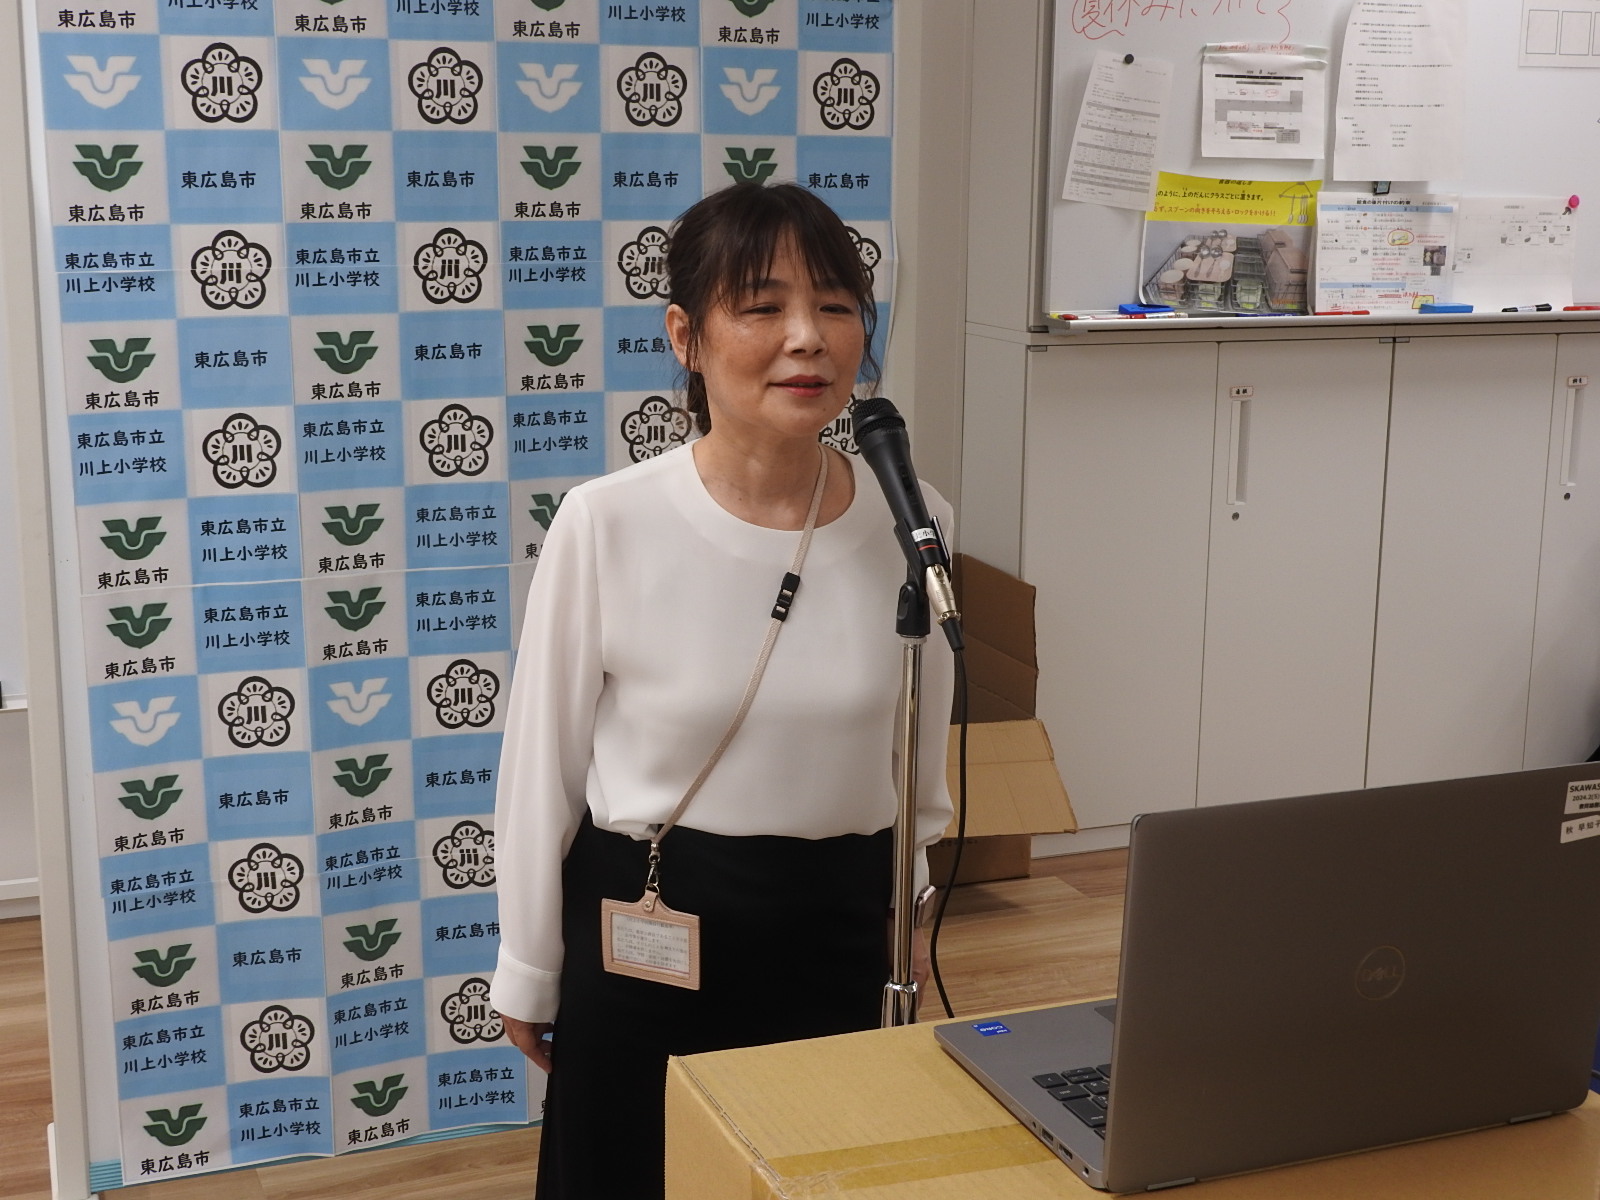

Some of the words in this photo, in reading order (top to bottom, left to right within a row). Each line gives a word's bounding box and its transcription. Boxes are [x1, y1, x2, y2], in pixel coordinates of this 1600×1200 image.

[397, 0, 479, 16] 川上小学校
[608, 5, 685, 22] 川上小学校
[58, 9, 135, 28] 東広島市
[295, 14, 366, 33] 東広島市
[807, 13, 879, 29] 川上小学校
[513, 20, 580, 38] 東広島市
[718, 26, 780, 44] 東広島市
[211, 76, 233, 96] 川
[436, 79, 455, 98] 川
[642, 83, 660, 102] 川
[836, 88, 854, 106] 川
[182, 171, 256, 188] 東広島市
[407, 171, 474, 187] 東広島市
[613, 171, 678, 187] 東広島市
[808, 173, 869, 189] 東広島市
[1156, 190, 1264, 201] のように、上のだんにクラスごとに置きます。
[69, 204, 144, 222] 東広島市
[301, 202, 372, 219] 東広島市
[515, 201, 581, 218] 東広島市
[65, 252, 154, 269] 東広島市立
[296, 248, 379, 265] 東広島市立
[509, 246, 587, 261] 東広島市立
[220, 263, 241, 284] 川
[440, 259, 459, 279] 川
[509, 266, 586, 282] 川上小学校
[67, 276, 155, 293] 川上小学校
[296, 271, 379, 287] 川上小学校
[415, 343, 482, 361] 東広島市
[617, 337, 672, 354] 東広島
[195, 350, 267, 368] 東広島市
[311, 381, 381, 400] 東広島市
[521, 373, 585, 391] 東広島市
[85, 390, 159, 409] 東広島市
[303, 419, 384, 437] 東広島市立
[513, 410, 587, 427] 東広島市立
[834, 418, 850, 436] 川
[78, 429, 165, 449] 東広島市立
[446, 434, 466, 453] 川
[515, 435, 588, 453] 川上小学校
[646, 425, 665, 444] 川
[231, 444, 253, 464] 川
[305, 446, 385, 464] 川上小学校
[80, 456, 166, 476] 川上小学校
[416, 505, 496, 522] 東広島市立
[201, 518, 286, 536] 東広島市立
[417, 531, 497, 548] 川上小学校
[203, 544, 287, 562] 川上小学校
[319, 552, 385, 573] 東広島市
[98, 567, 168, 589] 東広島市
[416, 589, 496, 607] 東広島市立
[204, 604, 288, 623] 東広島市立
[417, 614, 497, 632] 川上小学校
[206, 630, 290, 648] 川上小学校
[323, 639, 388, 660] 東広島市
[105, 656, 175, 679] 東広島市
[453, 687, 473, 706] 川
[247, 704, 267, 724] 川
[426, 769, 491, 787] 東広島市
[219, 789, 289, 809] 東広島市
[329, 805, 392, 829] 東広島市
[114, 828, 184, 852] 東広島市
[325, 845, 401, 870] 東広島市立
[460, 849, 479, 867] 川
[110, 869, 195, 894] 東広島市立
[256, 872, 276, 890] 川
[327, 864, 403, 890] 川上小学校
[112, 889, 196, 914] 川上小学校
[435, 922, 499, 941] 東広島市
[233, 948, 301, 967] 東広島市
[341, 964, 404, 989] 東広島市
[131, 990, 199, 1014] 東広島市
[334, 998, 408, 1024] 東広島市立
[466, 1005, 485, 1023] 川
[122, 1025, 206, 1051] 東広島市立
[268, 1033, 287, 1050] 川
[336, 1021, 409, 1048] 川上小学校
[124, 1049, 207, 1073] 川上小学校
[438, 1067, 514, 1087] 東広島市立
[240, 1097, 319, 1118] 東広島市立
[439, 1090, 515, 1109] 川上小学校
[241, 1121, 321, 1141] 川上小学校
[348, 1119, 410, 1146] 東広島市
[141, 1150, 210, 1176] 東広島市
